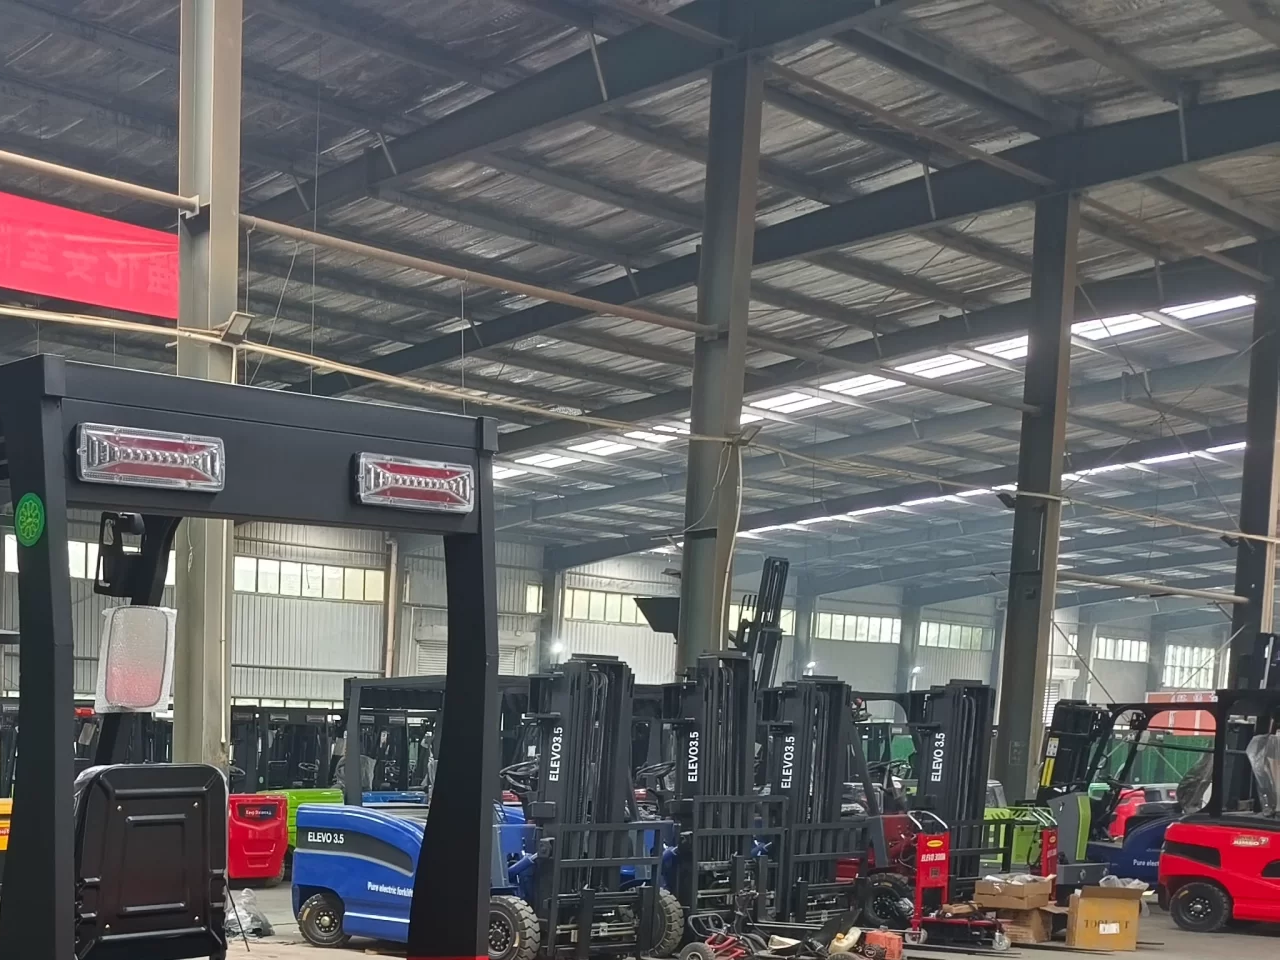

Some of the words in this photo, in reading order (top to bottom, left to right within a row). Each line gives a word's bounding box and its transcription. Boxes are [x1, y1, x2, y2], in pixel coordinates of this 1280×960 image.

[307, 832, 332, 843] ELEVO
[333, 833, 345, 844] 3.5
[367, 881, 379, 892] Pure
[379, 884, 396, 894] electric
